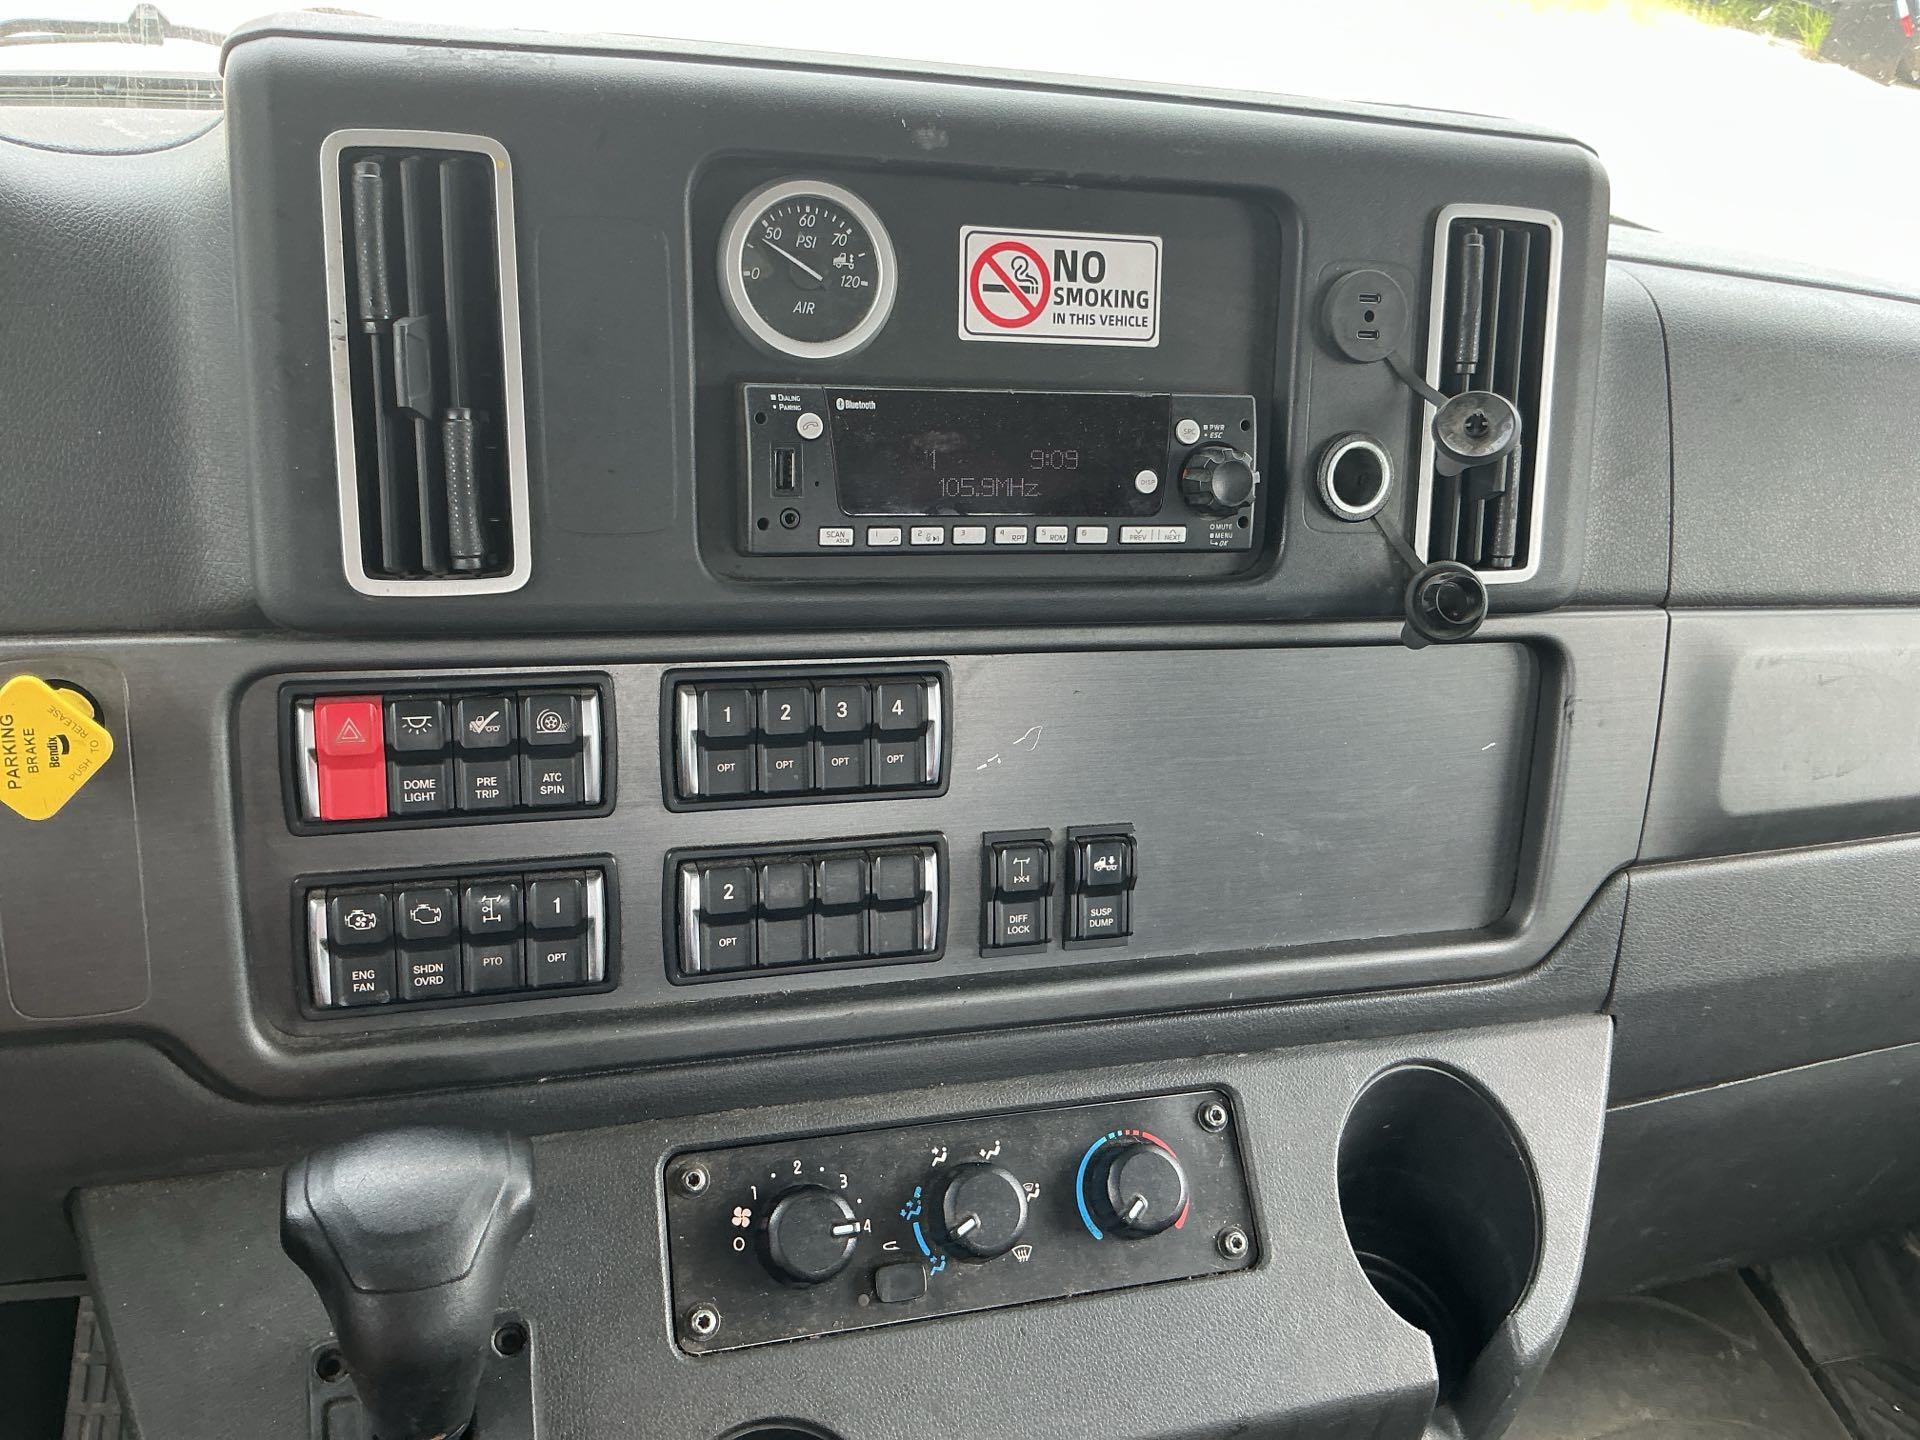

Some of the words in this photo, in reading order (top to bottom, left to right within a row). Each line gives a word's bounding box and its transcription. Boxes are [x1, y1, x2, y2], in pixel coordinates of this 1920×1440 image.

[799, 214, 816, 228] 60
[765, 227, 782, 240] 50
[831, 233, 848, 247] 70
[795, 235, 817, 249] PSI
[751, 267, 761, 280] 0
[1053, 249, 1106, 284] NO
[840, 275, 861, 289] 120
[1053, 286, 1149, 310] SMOKING
[793, 301, 815, 315] AIR
[1052, 312, 1066, 325] IN
[1069, 313, 1096, 326] THIS
[1099, 314, 1149, 328] VEHICLE
[845, 400, 876, 410] Bluetooth
[1030, 449, 1079, 470] 9:09
[938, 477, 1042, 497] 105.9MHz
[723, 706, 732, 723] 1
[779, 704, 791, 721] 2
[836, 701, 848, 718] 3
[891, 699, 904, 716] 4
[48, 706, 88, 739] RELEASE
[0, 714, 22, 789] PARKING
[23, 728, 39, 774] BRAKE
[47, 736, 61, 768] Bendix
[89, 739, 100, 754] TO
[775, 759, 794, 770] OPT
[831, 757, 850, 767] OPT
[886, 754, 904, 764] OPT
[69, 758, 92, 781] PUSH
[717, 762, 736, 773] OPT
[403, 779, 436, 790] DOME
[476, 776, 498, 787] PRE
[542, 772, 562, 783] ATC
[475, 788, 500, 799] TRIP
[540, 784, 565, 795] SPIN
[404, 791, 436, 803] LIGHT
[722, 883, 734, 900] 2
[552, 896, 561, 914] 1
[1090, 907, 1113, 917] SUSP
[1009, 914, 1029, 924] DIFF
[1089, 918, 1114, 928] DUMP
[1007, 925, 1031, 934] LOCK
[718, 936, 737, 948] OPT
[483, 956, 503, 967] PTO
[547, 952, 568, 963] OPT
[352, 969, 375, 981] ENG
[413, 963, 444, 975] SHDN
[353, 981, 375, 993] FAN
[414, 975, 444, 987] OVRD
[793, 1160, 802, 1175] 2
[839, 1173, 849, 1189] 3
[750, 1185, 758, 1200] 1
[863, 1218, 872, 1233] 4
